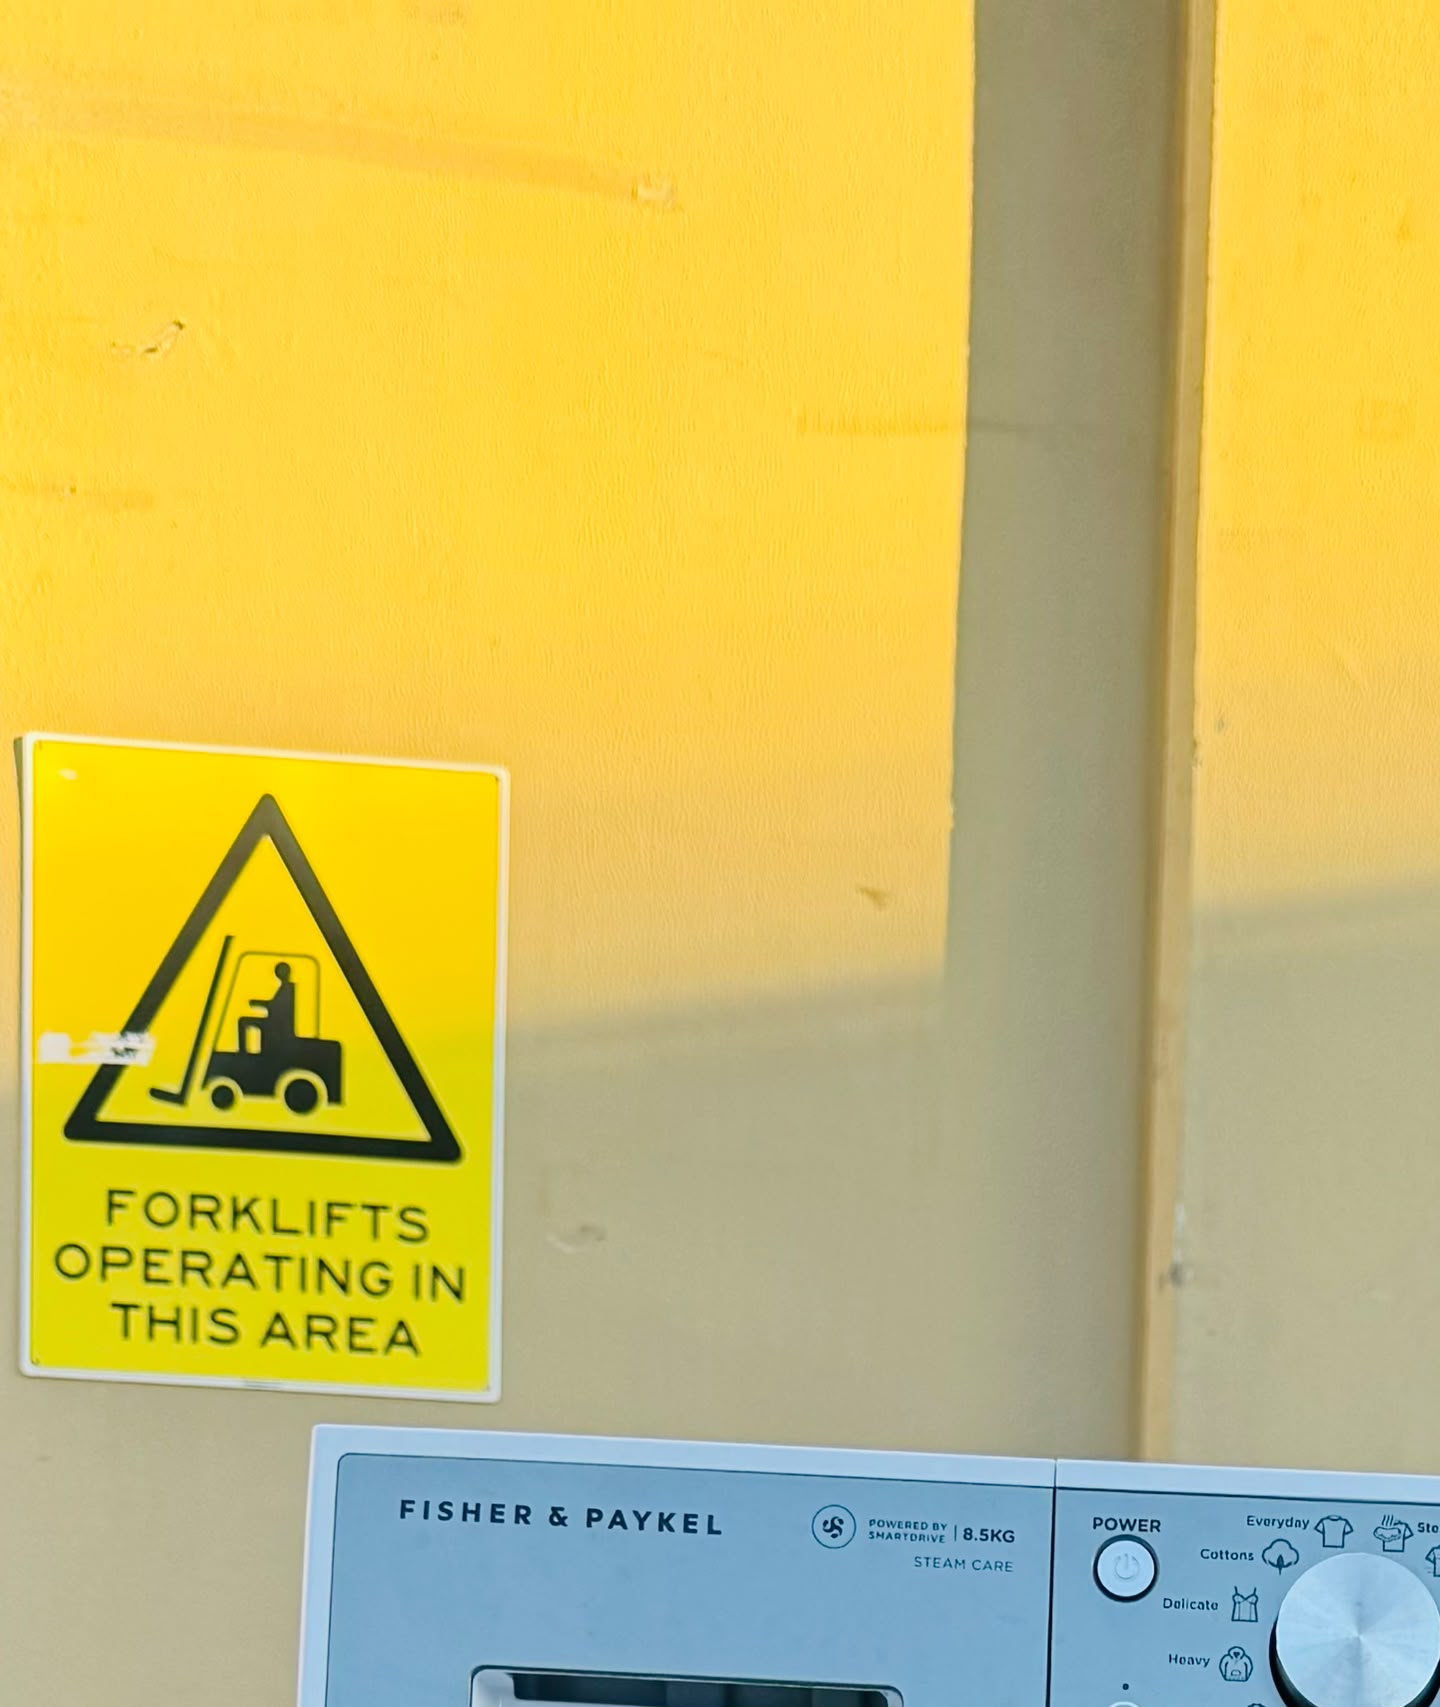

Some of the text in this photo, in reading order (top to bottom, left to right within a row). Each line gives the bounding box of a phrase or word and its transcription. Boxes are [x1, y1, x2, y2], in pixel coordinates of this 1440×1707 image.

[107, 1188, 430, 1243] FORKLIFTS
[54, 1243, 466, 1303] OPERATING IN
[110, 1302, 421, 1357] THIS AREA
[399, 1499, 722, 1535] FISHER & PAYKEL
[869, 1518, 947, 1531] POWERED BY
[1092, 1517, 1161, 1532] POWER
[1246, 1515, 1309, 1530] Everyday
[962, 1527, 1015, 1543] 8.5KG
[1200, 1548, 1254, 1561] Cottons
[914, 1556, 1014, 1572] STEAM CARE
[1163, 1598, 1219, 1611] Delicate
[1168, 1653, 1210, 1668] Heavy
